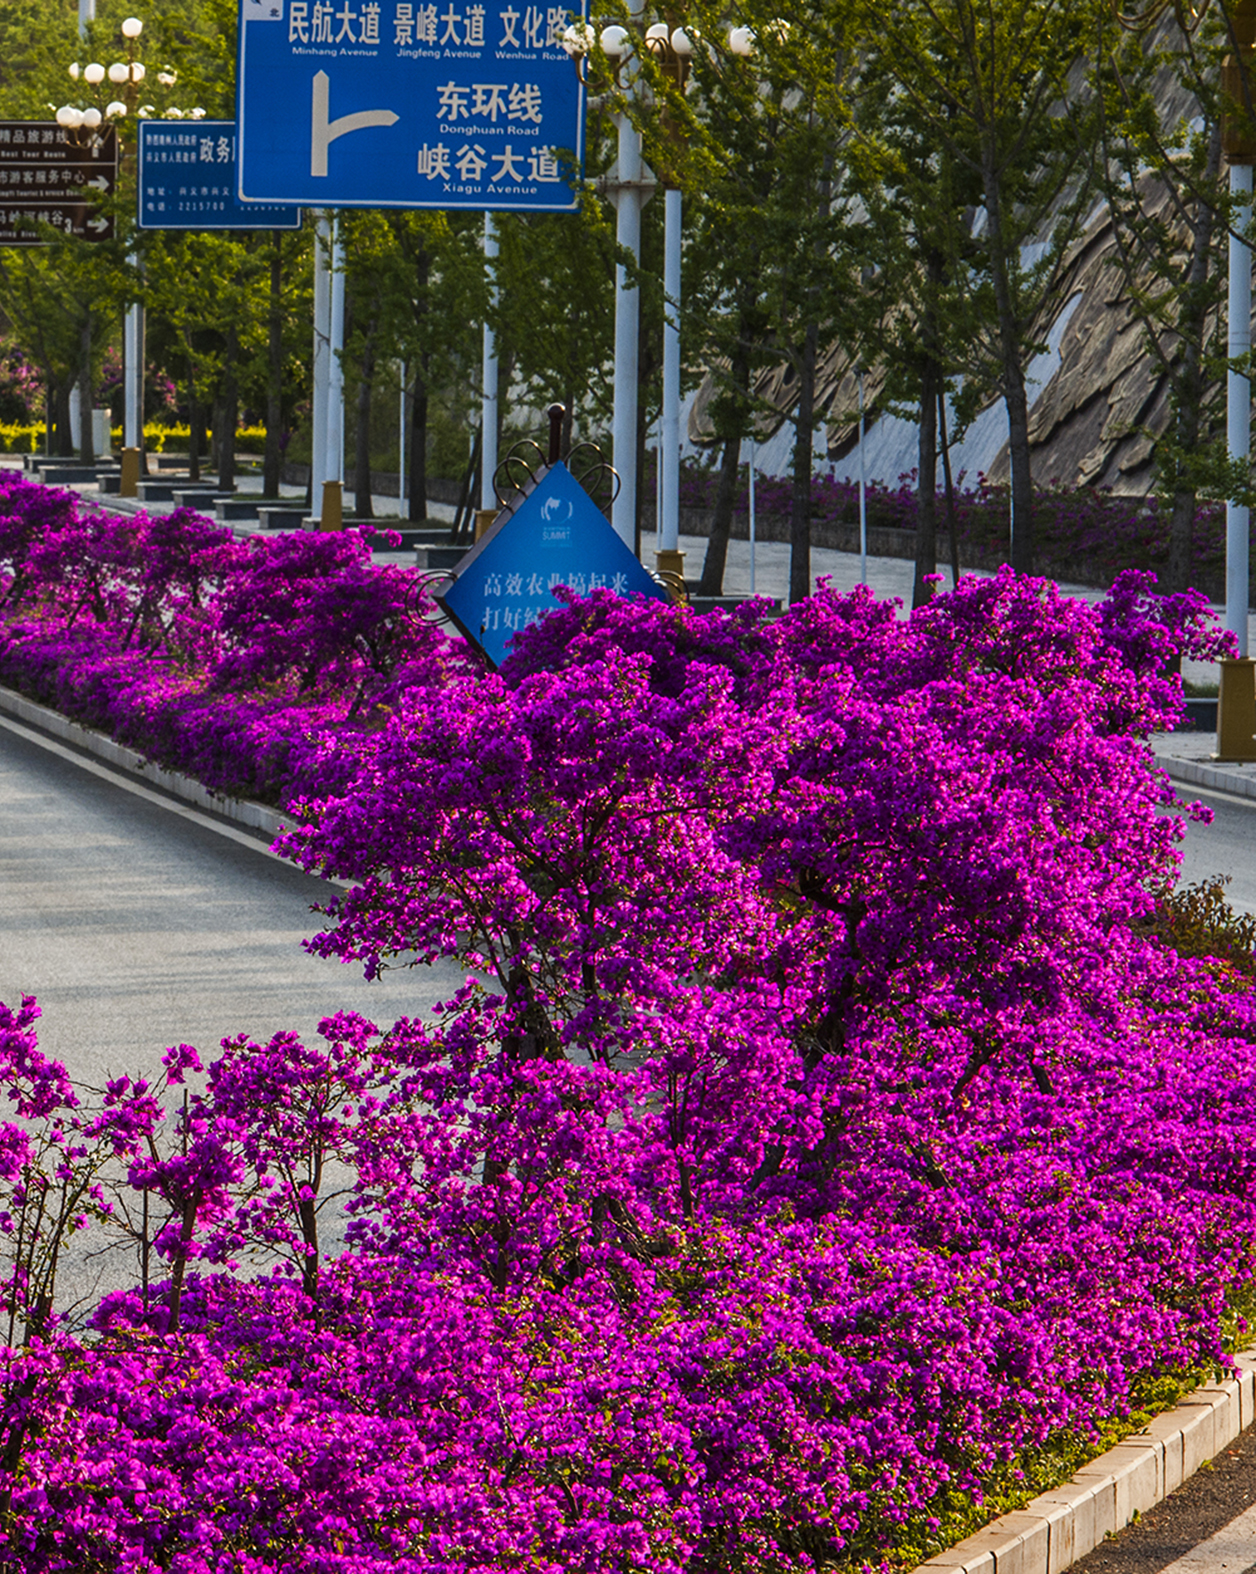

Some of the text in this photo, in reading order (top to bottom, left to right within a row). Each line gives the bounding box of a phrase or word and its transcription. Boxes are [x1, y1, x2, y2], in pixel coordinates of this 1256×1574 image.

[269, 8, 280, 17] 北
[288, 1, 569, 49] 民航大道 景峰大道 文化路
[292, 47, 569, 61] Minhang Avenue Jingfeng Avenue Wenhua Road
[436, 81, 543, 124] 东环线
[440, 124, 539, 136] Donghuan Road
[200, 135, 235, 163] 政务
[418, 142, 561, 183] 峡谷大道
[443, 183, 537, 194] Xiagu Avenue
[64, 218, 72, 234] 3
